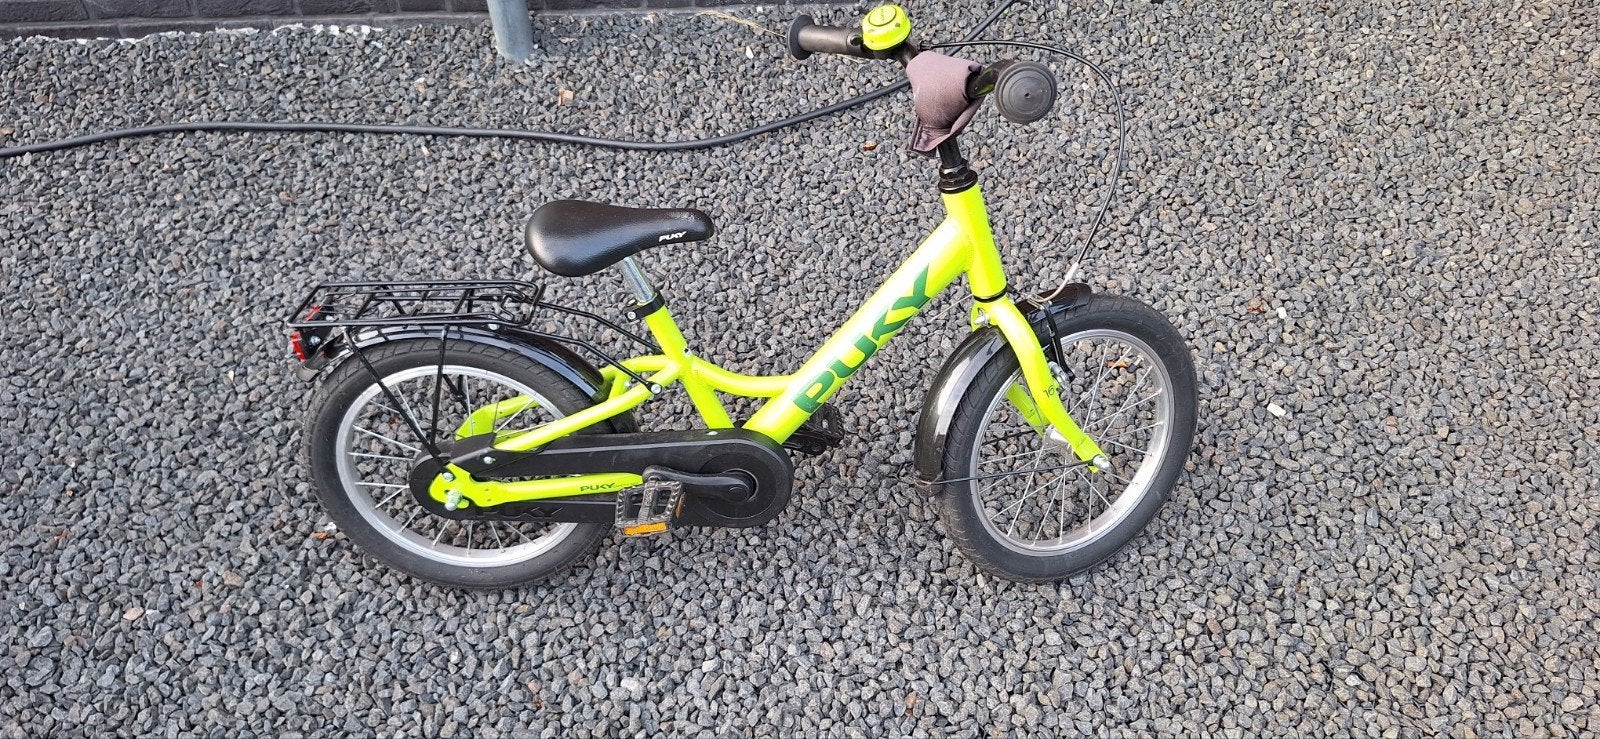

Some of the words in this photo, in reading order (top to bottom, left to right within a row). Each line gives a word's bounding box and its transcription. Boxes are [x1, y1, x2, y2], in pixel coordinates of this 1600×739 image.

[658, 231, 686, 242] PUKY
[793, 263, 931, 413] PUKY
[1043, 384, 1055, 398] 16
[580, 483, 615, 491] PUKY
